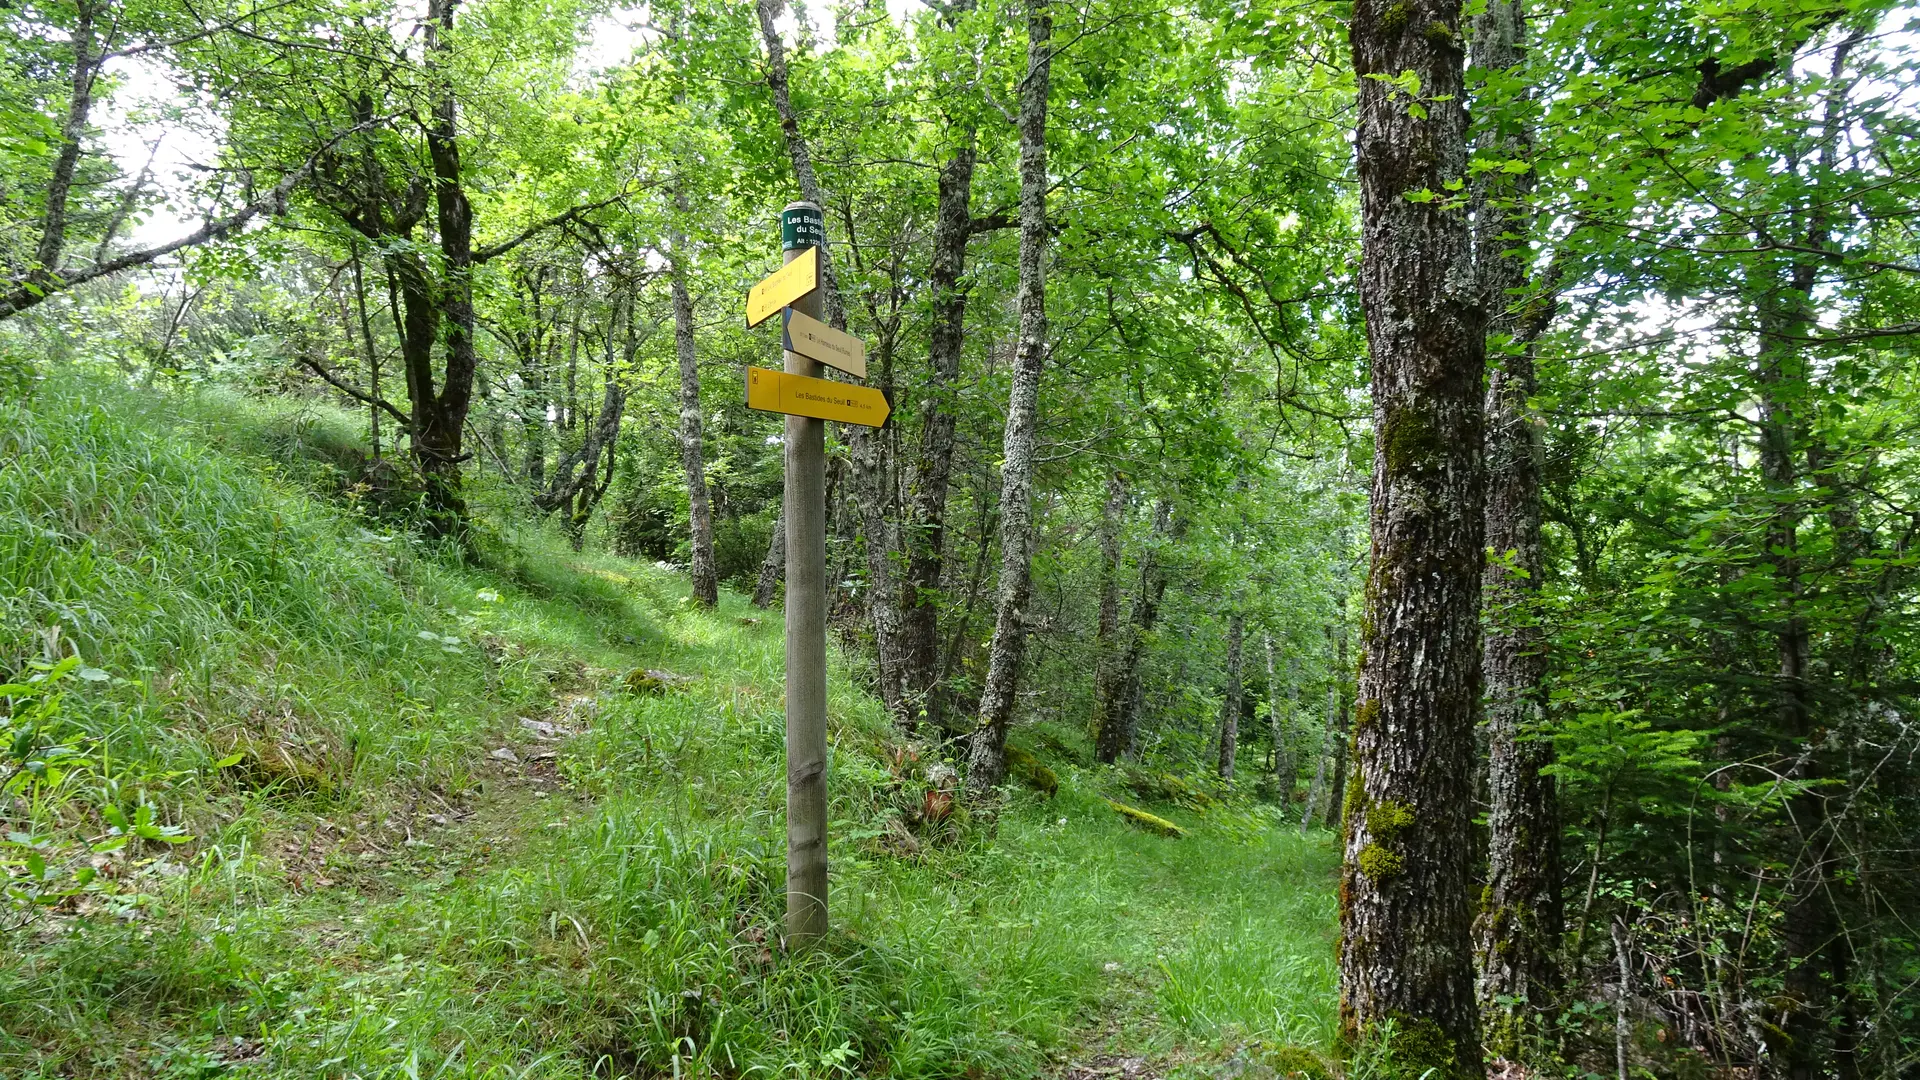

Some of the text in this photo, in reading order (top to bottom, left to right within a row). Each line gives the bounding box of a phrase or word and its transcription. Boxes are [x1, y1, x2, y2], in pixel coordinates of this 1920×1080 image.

[796, 225, 807, 233] du
[795, 391, 804, 399] Les
[805, 392, 825, 402] Bastides
